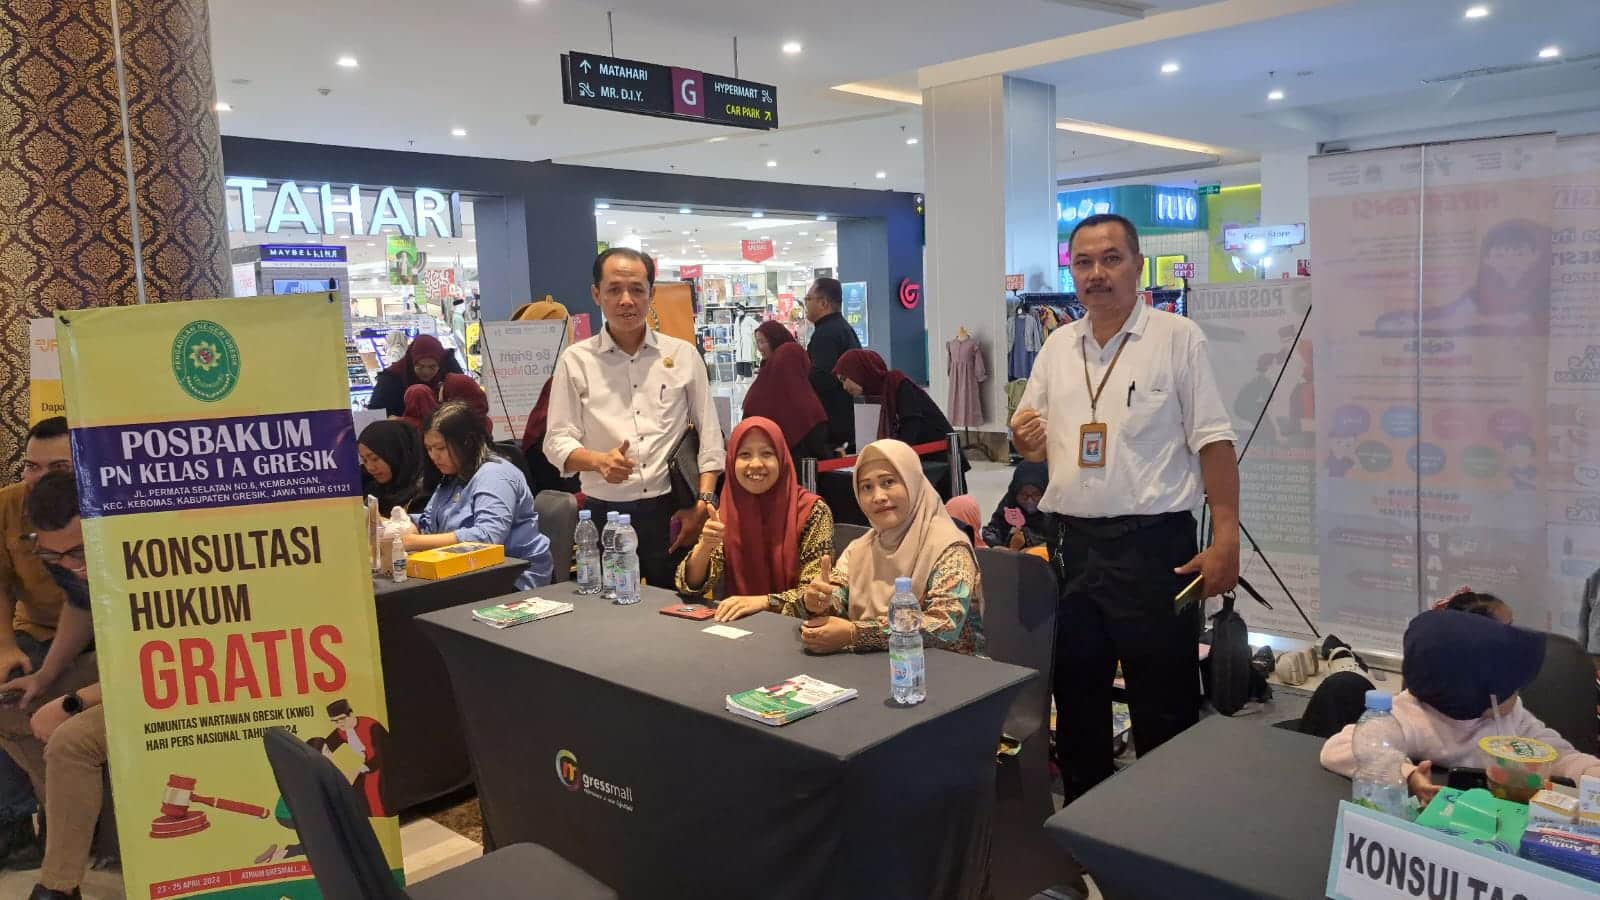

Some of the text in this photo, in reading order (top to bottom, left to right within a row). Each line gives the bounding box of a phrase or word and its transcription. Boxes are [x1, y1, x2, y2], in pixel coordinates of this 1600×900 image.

[599, 64, 648, 80] MATAHARI
[600, 86, 644, 102] MR. D.I.Y.
[681, 79, 697, 105] G
[714, 82, 758, 99] HYPERMART
[726, 104, 760, 119] CAR PARK
[226, 177, 462, 238] TAHARI
[41, 402, 64, 414] Dapa
[121, 418, 313, 460] POSBAKUM
[100, 449, 338, 487] PN KELAS I A GRESIK
[103, 502, 126, 511] KEC.
[128, 498, 175, 509] KEBOMAS,
[177, 493, 230, 505] KABUPATEN
[271, 488, 297, 499] JAWA
[299, 485, 326, 495] TIMUR
[327, 483, 351, 493] 61121
[134, 489, 147, 498] JL.
[149, 486, 191, 498] PERMATA
[191, 483, 232, 494] SELATAN
[122, 525, 322, 580] KONSULTASI
[129, 583, 251, 631] HUKUM
[139, 624, 347, 710] GRATIS
[144, 717, 198, 734] KOMUNITAS
[199, 711, 251, 728] WARTAWAN
[252, 708, 285, 722] GRESIK
[146, 738, 169, 752] HARI
[171, 735, 195, 748] PERS
[196, 729, 241, 745] NASIONAL
[582, 773, 633, 802] gressmall
[1345, 832, 1529, 900] KONSULT
[182, 879, 200, 890] APRIL
